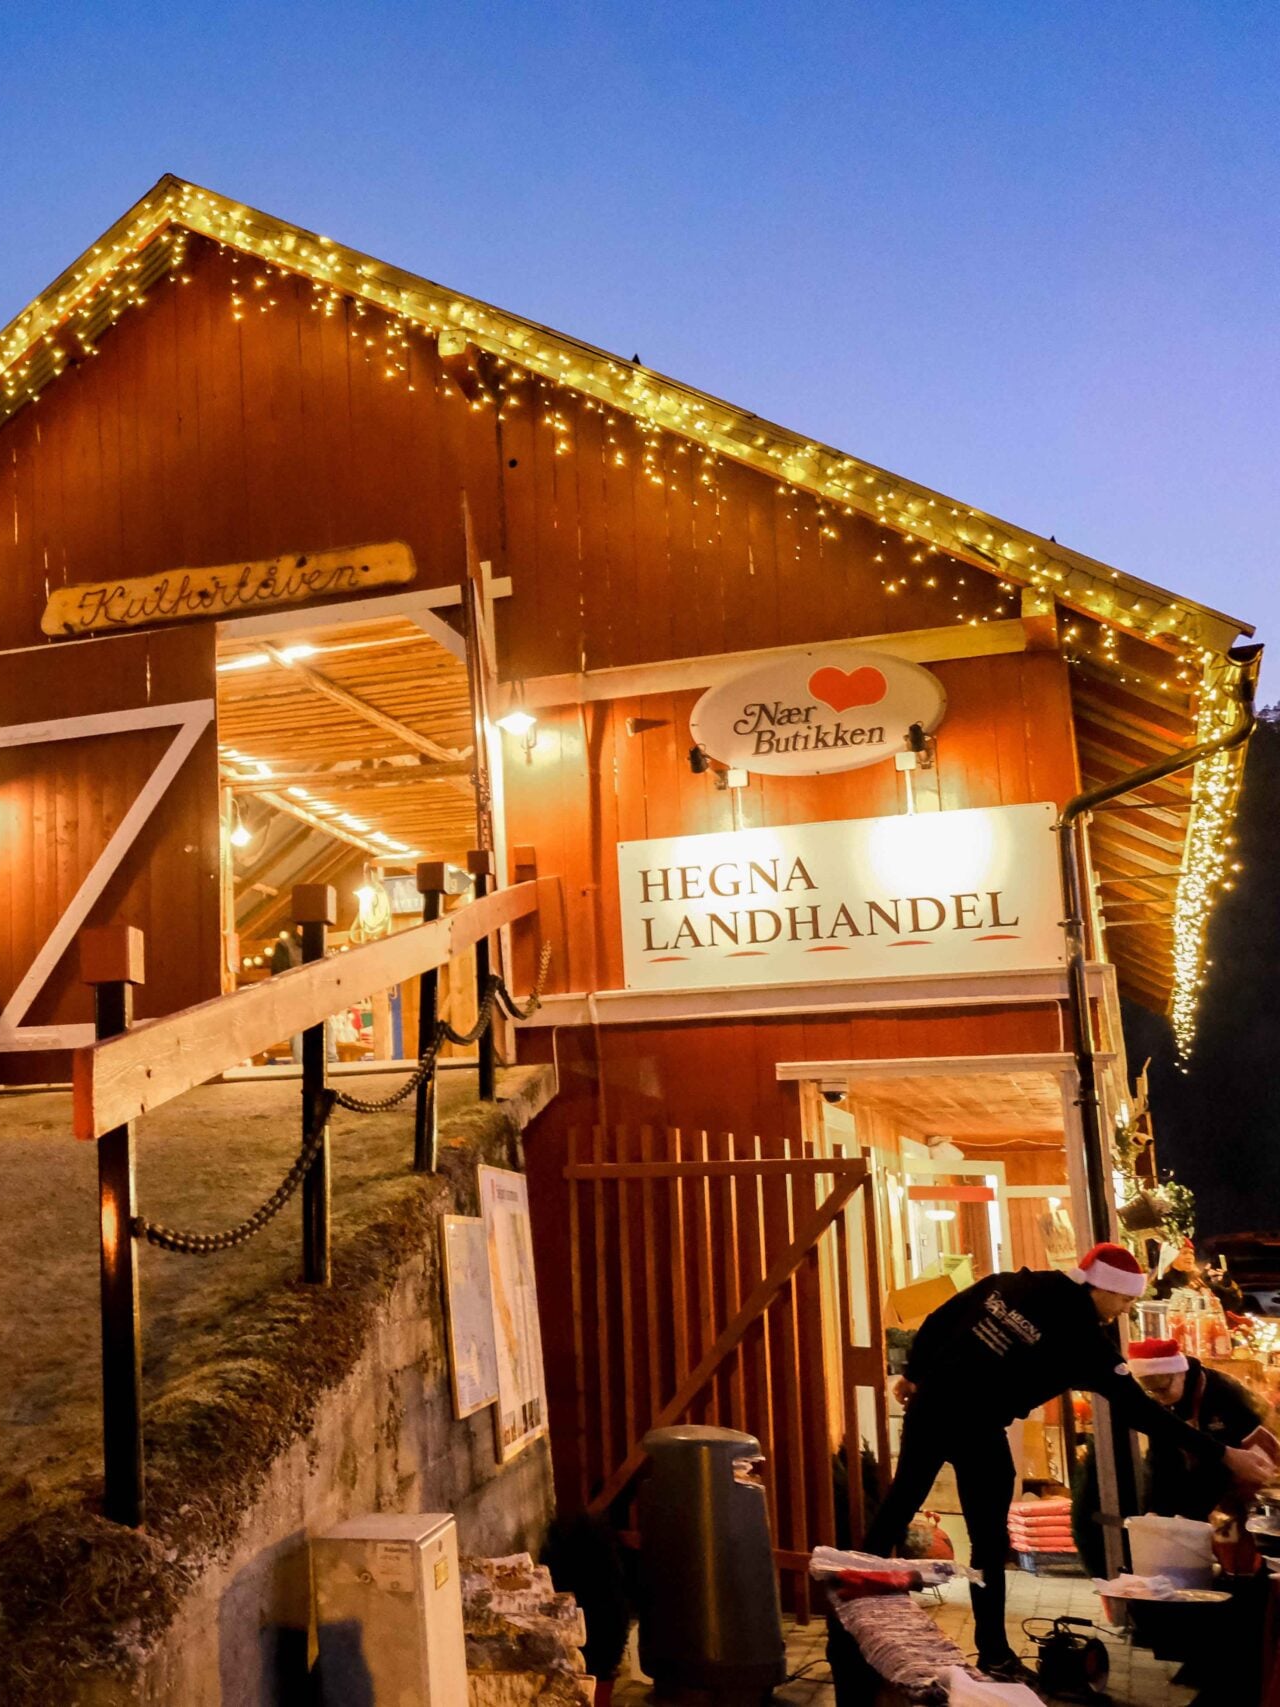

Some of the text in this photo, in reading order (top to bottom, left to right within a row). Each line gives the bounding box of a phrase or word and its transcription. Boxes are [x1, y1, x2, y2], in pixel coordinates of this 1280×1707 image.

[733, 702, 818, 736] Nær
[752, 724, 886, 757] Butikken
[639, 856, 819, 904] HEGNA
[641, 891, 1019, 951] LANDHANDEL
[1007, 1309, 1042, 1341] HEGNA
